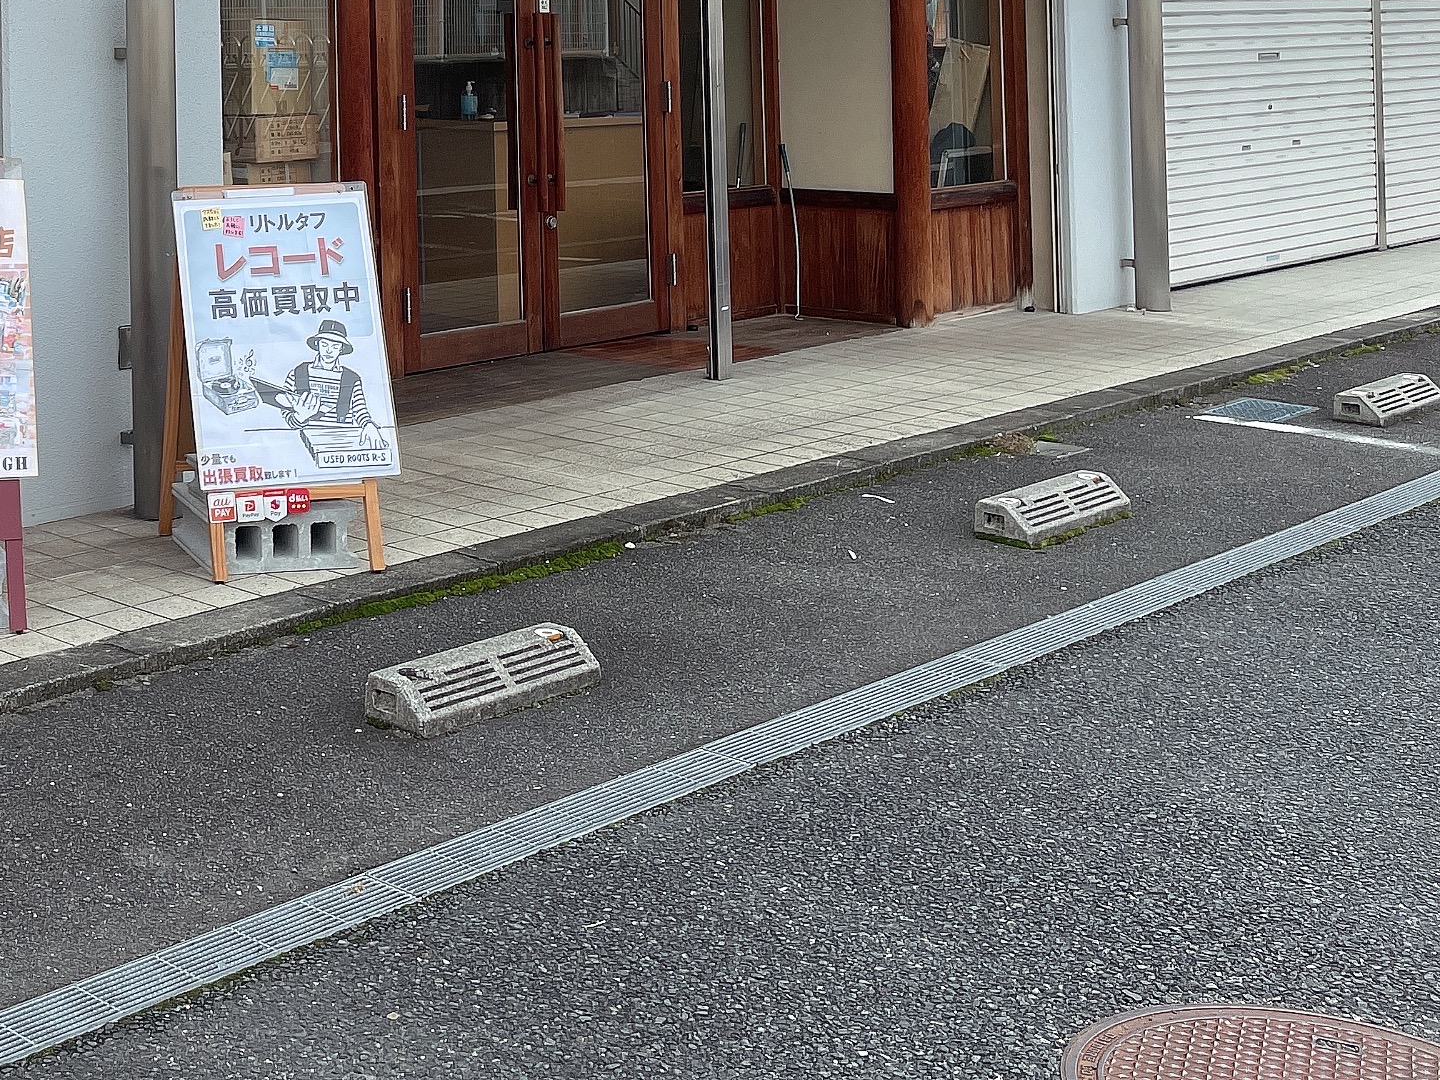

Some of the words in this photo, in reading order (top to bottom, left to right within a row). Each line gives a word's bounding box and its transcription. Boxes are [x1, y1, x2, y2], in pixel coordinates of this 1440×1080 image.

[250, 212, 326, 233] リトルタフ
[215, 237, 344, 281] レコード
[208, 281, 360, 319] 高価買取中
[200, 453, 237, 466] 少量でも
[323, 454, 345, 464] USED
[347, 453, 370, 463] ROOTS
[213, 496, 232, 507] au
[214, 507, 232, 518] PAY
